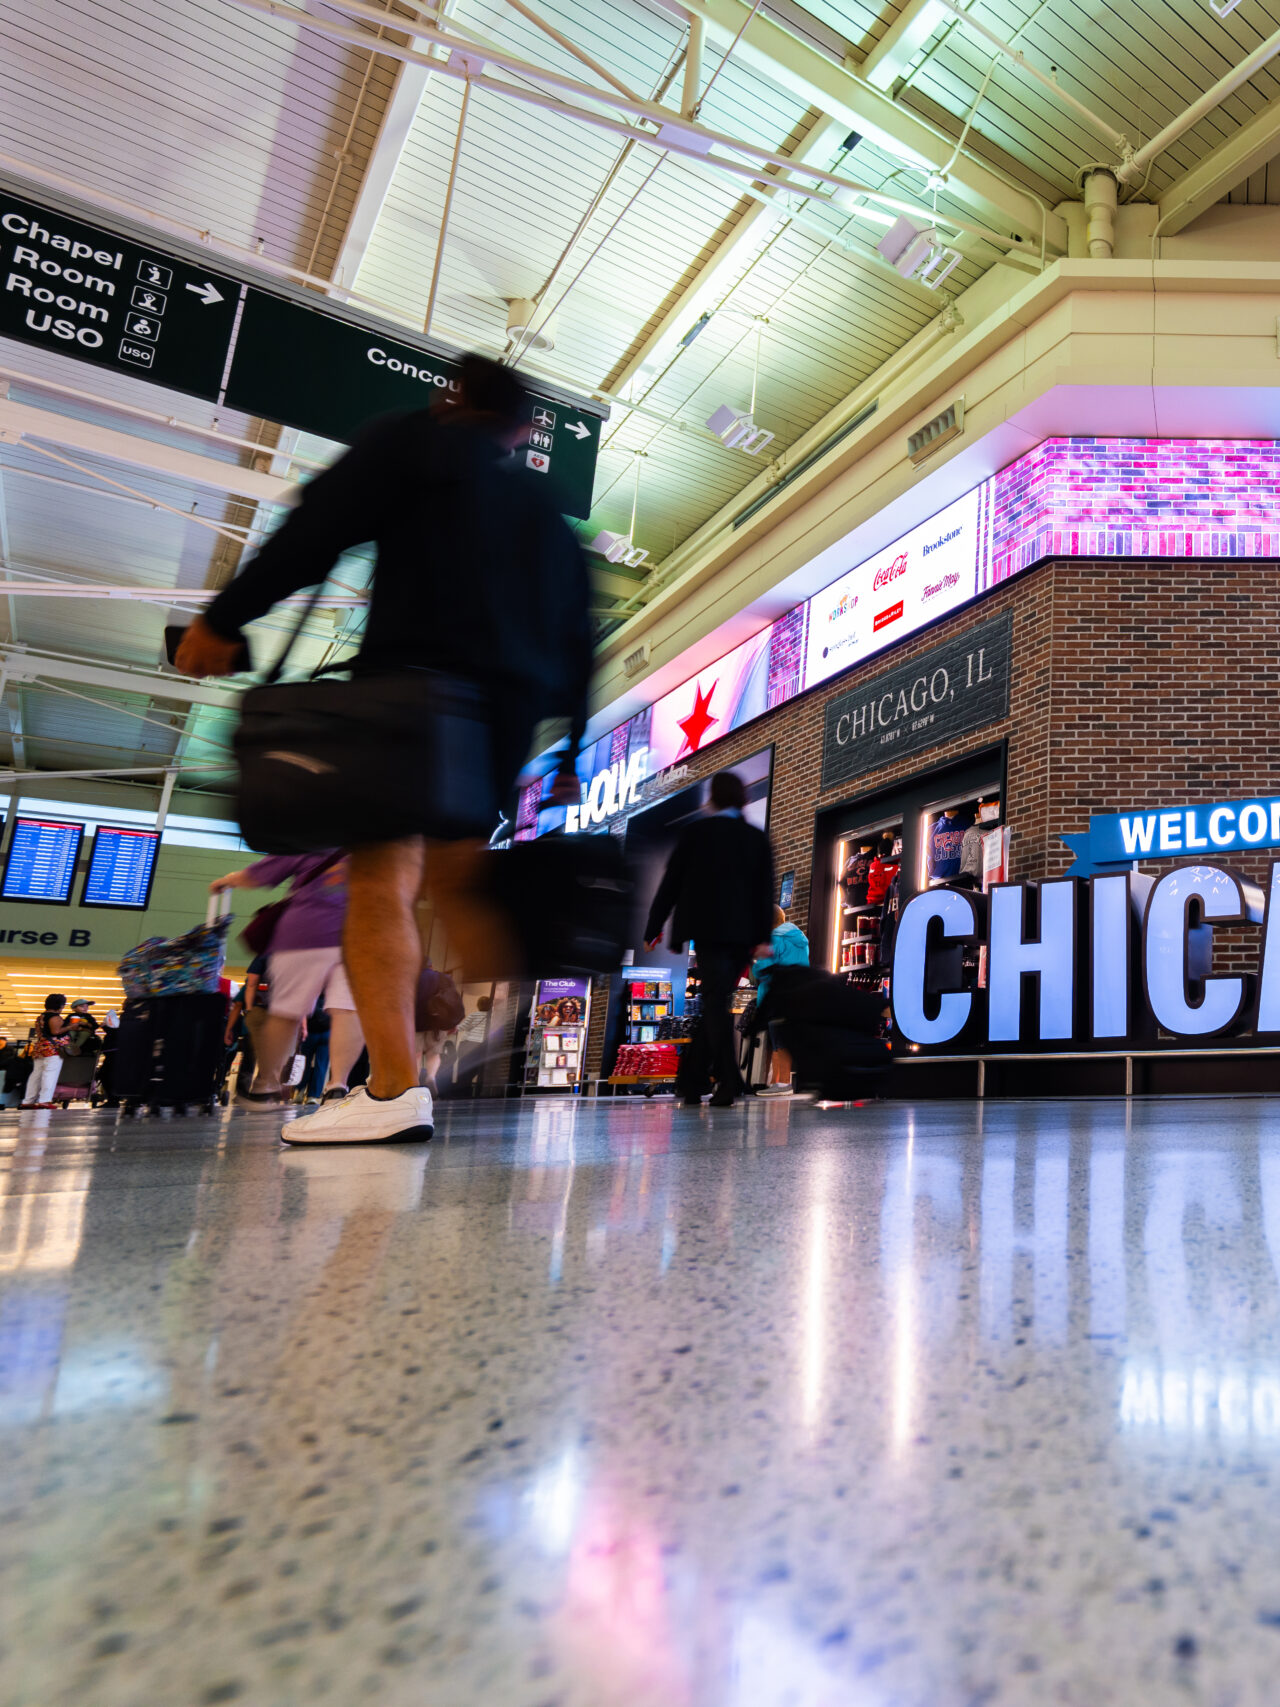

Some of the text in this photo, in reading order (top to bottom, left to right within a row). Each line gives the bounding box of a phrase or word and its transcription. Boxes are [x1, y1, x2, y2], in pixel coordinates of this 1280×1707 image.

[2, 213, 124, 270] Chapel
[13, 245, 116, 297] Room
[5, 272, 110, 323] Room
[25, 309, 104, 348] USO
[122, 345, 151, 361] USO
[367, 347, 463, 393] Concou
[836, 647, 993, 746] CHICAGO, IL
[68, 929, 91, 947] B
[558, 980, 576, 988] Club
